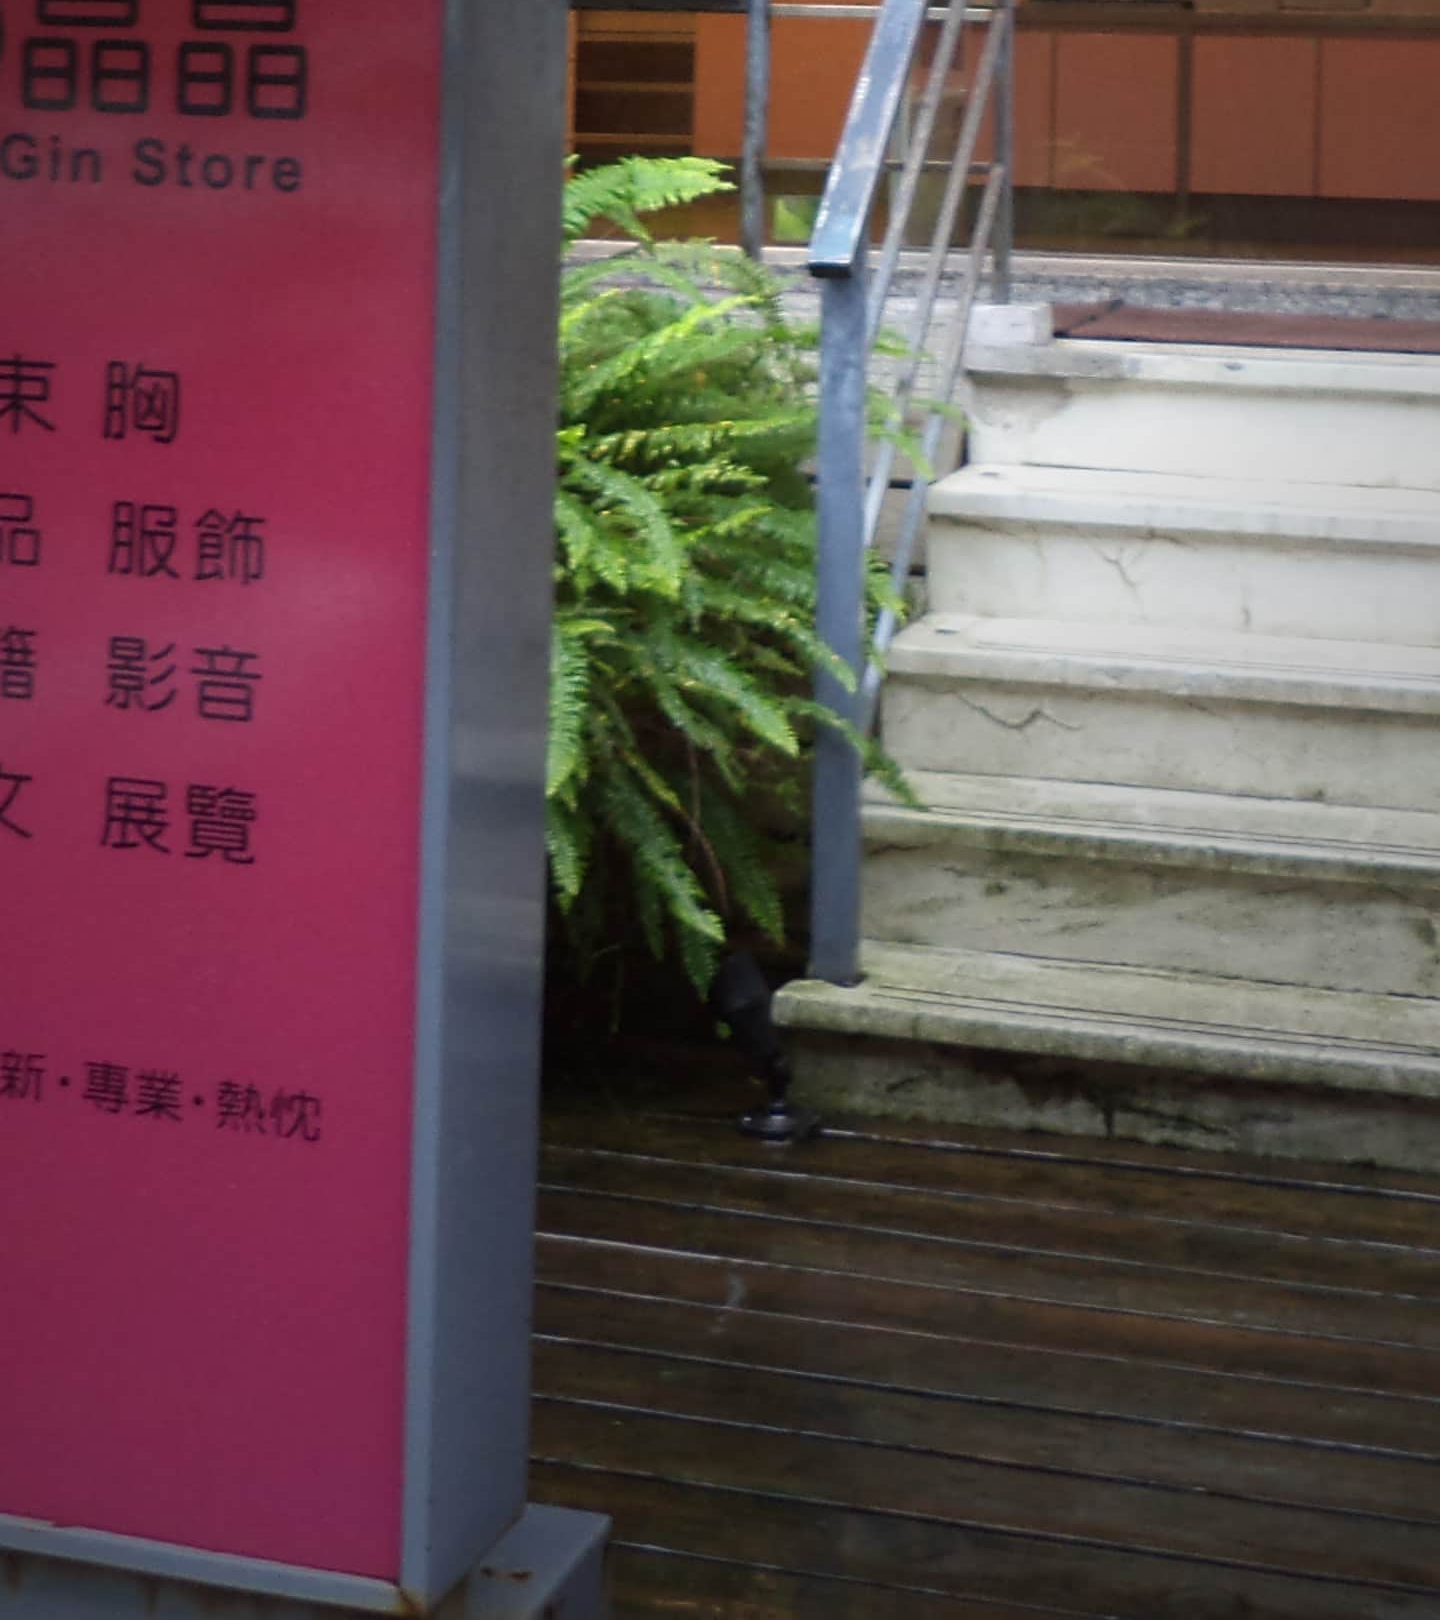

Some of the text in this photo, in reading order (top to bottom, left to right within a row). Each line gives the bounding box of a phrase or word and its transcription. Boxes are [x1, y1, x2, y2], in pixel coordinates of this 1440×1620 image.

[133, 138, 303, 193] Store
[106, 501, 268, 586] 服飾
[103, 635, 264, 724] 影音
[98, 776, 258, 866] 展覽
